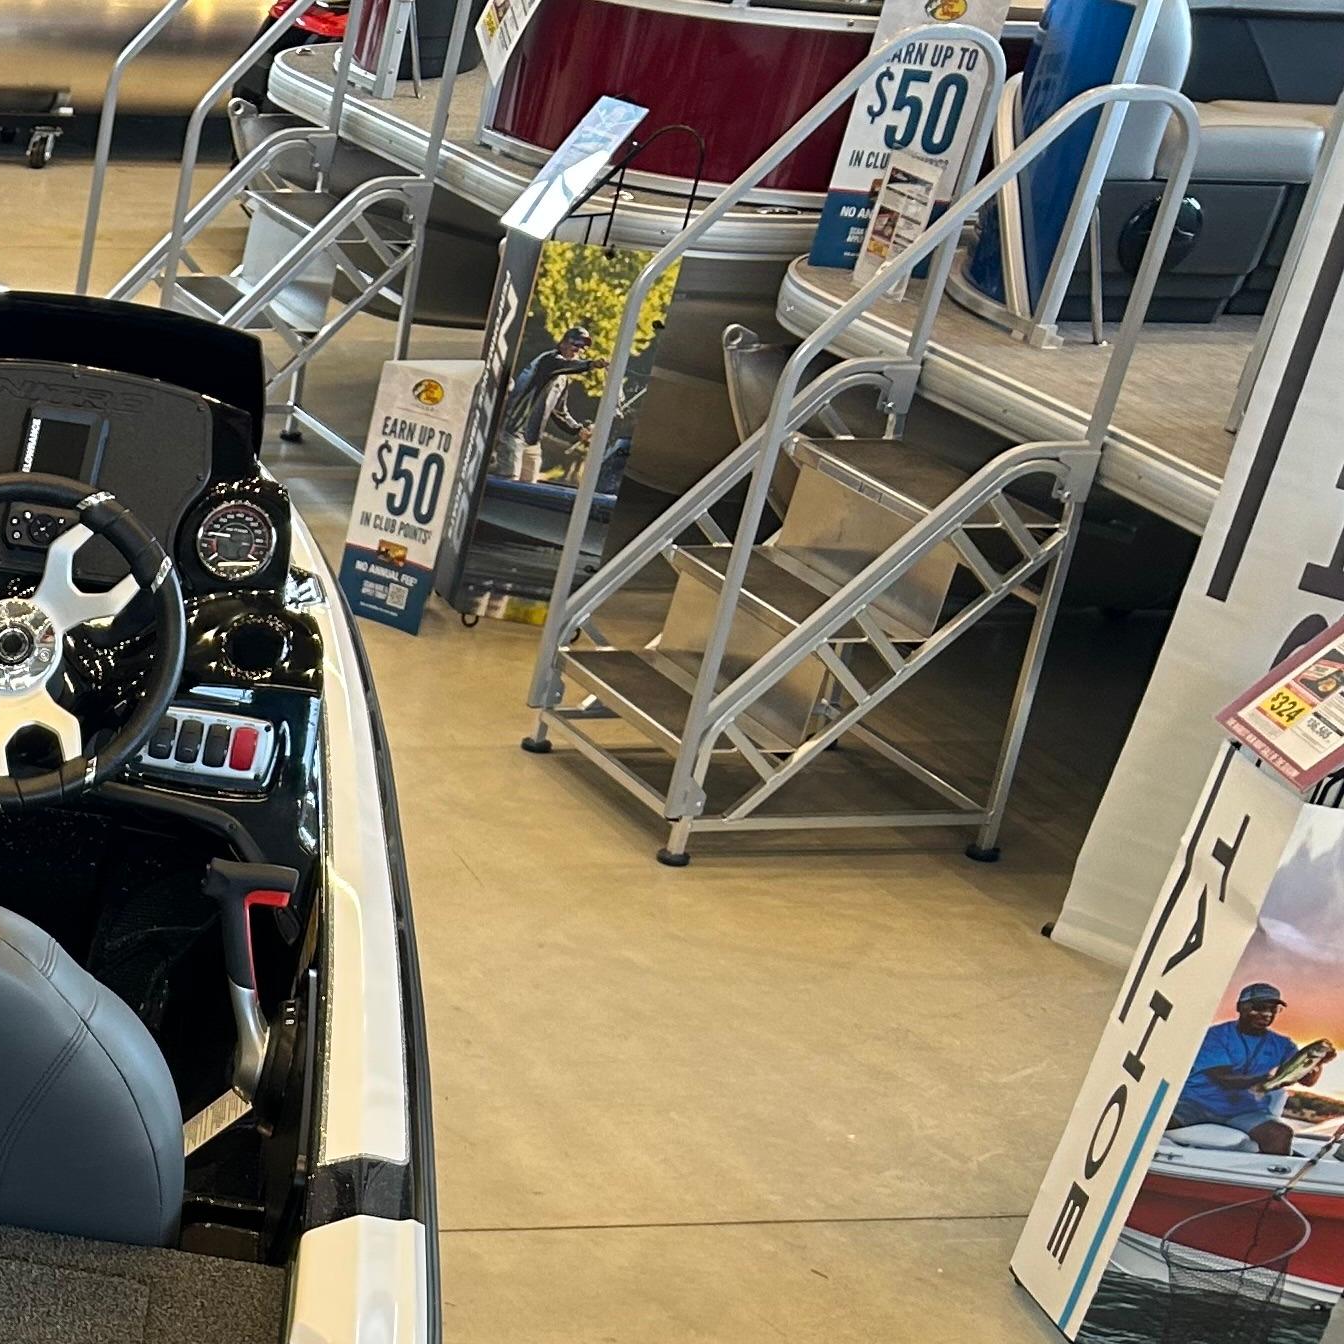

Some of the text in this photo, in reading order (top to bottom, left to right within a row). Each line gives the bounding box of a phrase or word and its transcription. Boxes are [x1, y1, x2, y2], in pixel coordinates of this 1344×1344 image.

[886, 42, 979, 72] ARN UP TO
[867, 66, 969, 155] $50
[849, 149, 865, 167] IN
[865, 150, 890, 170] CLU
[840, 205, 857, 218] NO
[382, 416, 452, 453] EARN UP TO
[372, 439, 446, 526] $50
[360, 510, 374, 527] IN
[374, 514, 397, 535] CLUB
[355, 560, 369, 572] NO
[369, 563, 400, 583] ANNUAL
[1271, 691, 1307, 723] $324
[1046, 815, 1252, 1265] TAHOE
